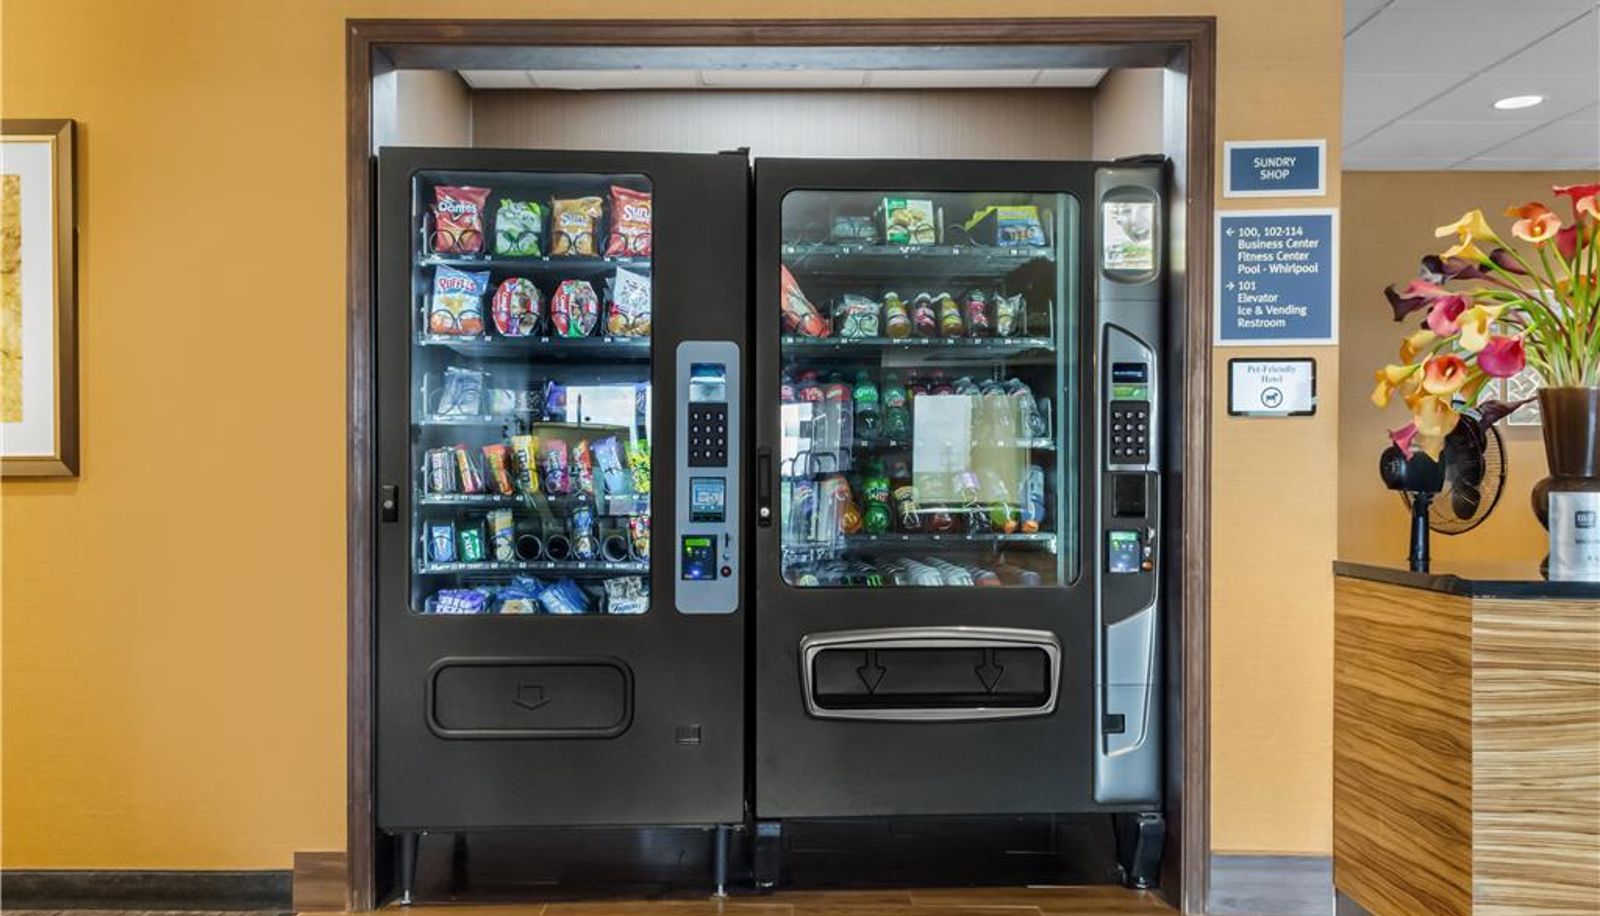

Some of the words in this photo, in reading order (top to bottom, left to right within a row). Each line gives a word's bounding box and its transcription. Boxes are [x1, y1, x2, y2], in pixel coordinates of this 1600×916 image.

[1253, 157, 1296, 168] SUNDRY
[1260, 169, 1290, 180] SHOP
[1238, 227, 1261, 238] 100,
[1264, 226, 1303, 237] 102-114
[1238, 239, 1284, 250] Business
[1286, 238, 1320, 249] Center
[1238, 251, 1275, 262] Fitness
[1276, 250, 1309, 261] Center
[1238, 264, 1260, 274] Pool
[1269, 262, 1319, 276] Whirlpool
[1239, 280, 1257, 291] 101
[1238, 293, 1278, 304] Elevator
[1238, 306, 1252, 316] Ice
[1255, 305, 1264, 315] &
[1265, 303, 1308, 317] Vending
[1238, 317, 1286, 328] Restroom
